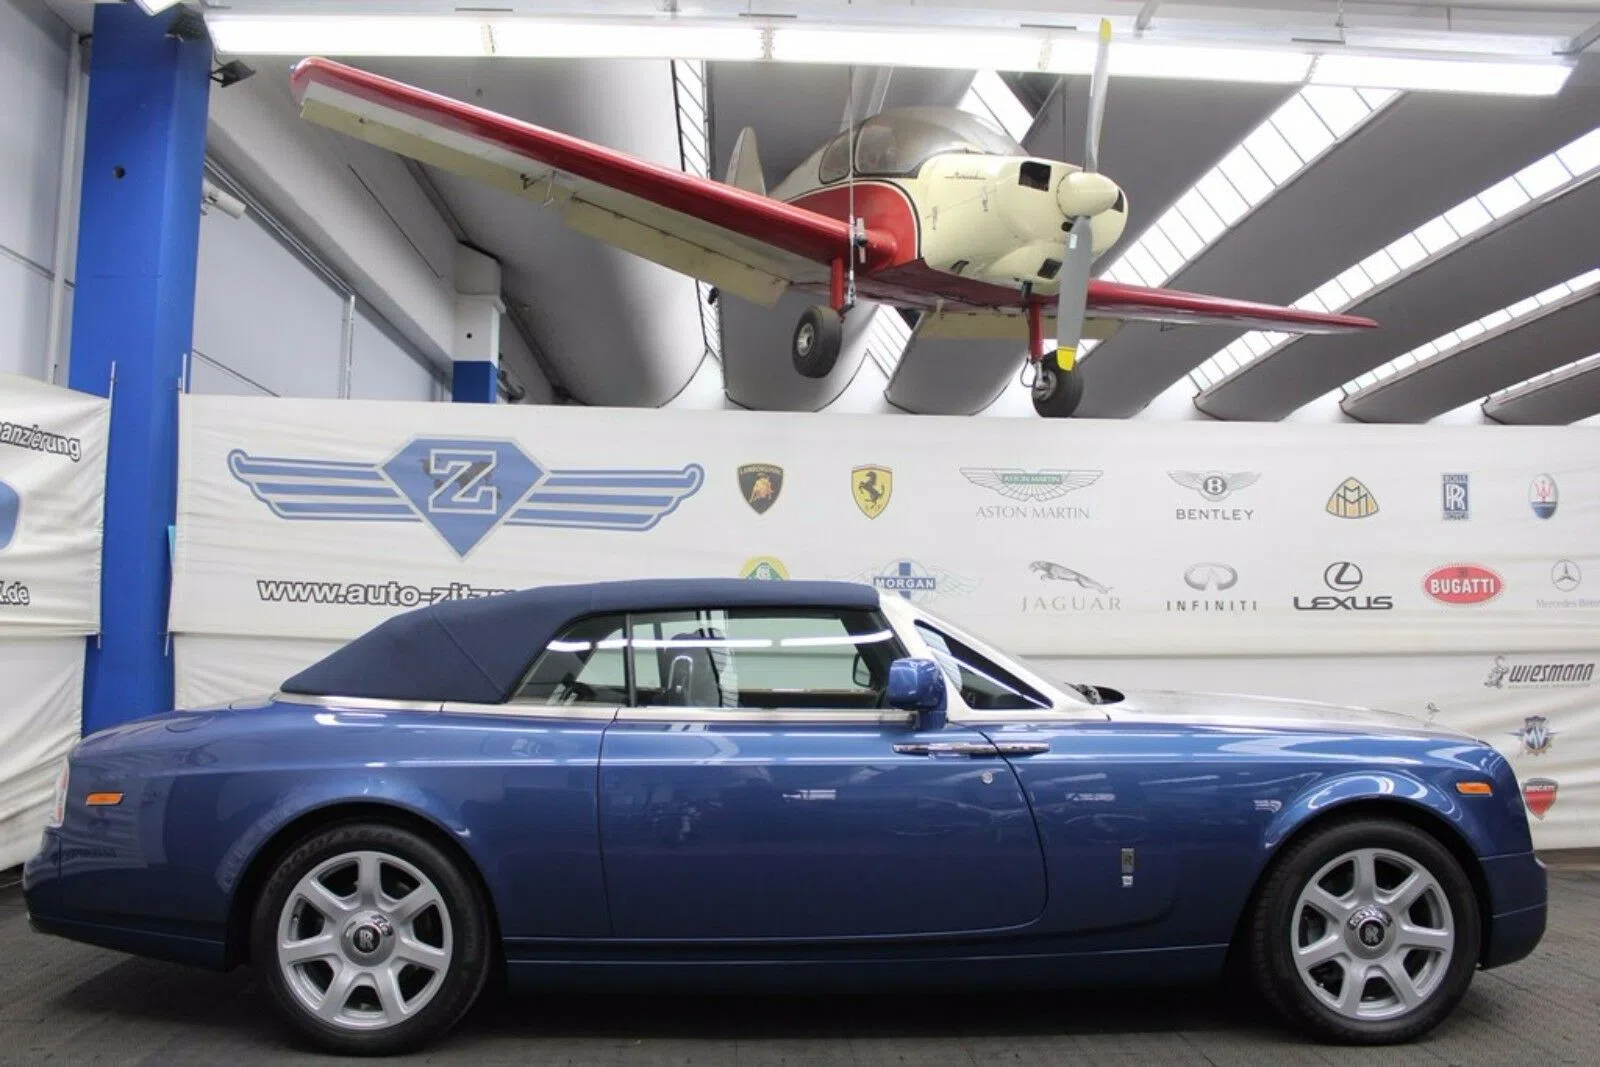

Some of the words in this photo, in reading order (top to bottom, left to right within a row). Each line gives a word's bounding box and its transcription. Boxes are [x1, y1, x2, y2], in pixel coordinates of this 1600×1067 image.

[0, 421, 82, 462] anzierung
[976, 505, 1027, 519] ASTON
[1032, 505, 1090, 519] MARTIN
[1175, 508, 1254, 520] BENTLEY
[875, 578, 935, 589] MORGAN
[1430, 578, 1495, 595] BUGATTI
[256, 580, 517, 607] www.auto-zit
[1021, 596, 1121, 612] JAGUAR
[1166, 600, 1258, 612] INFINITI
[1293, 596, 1393, 611] LEXUS
